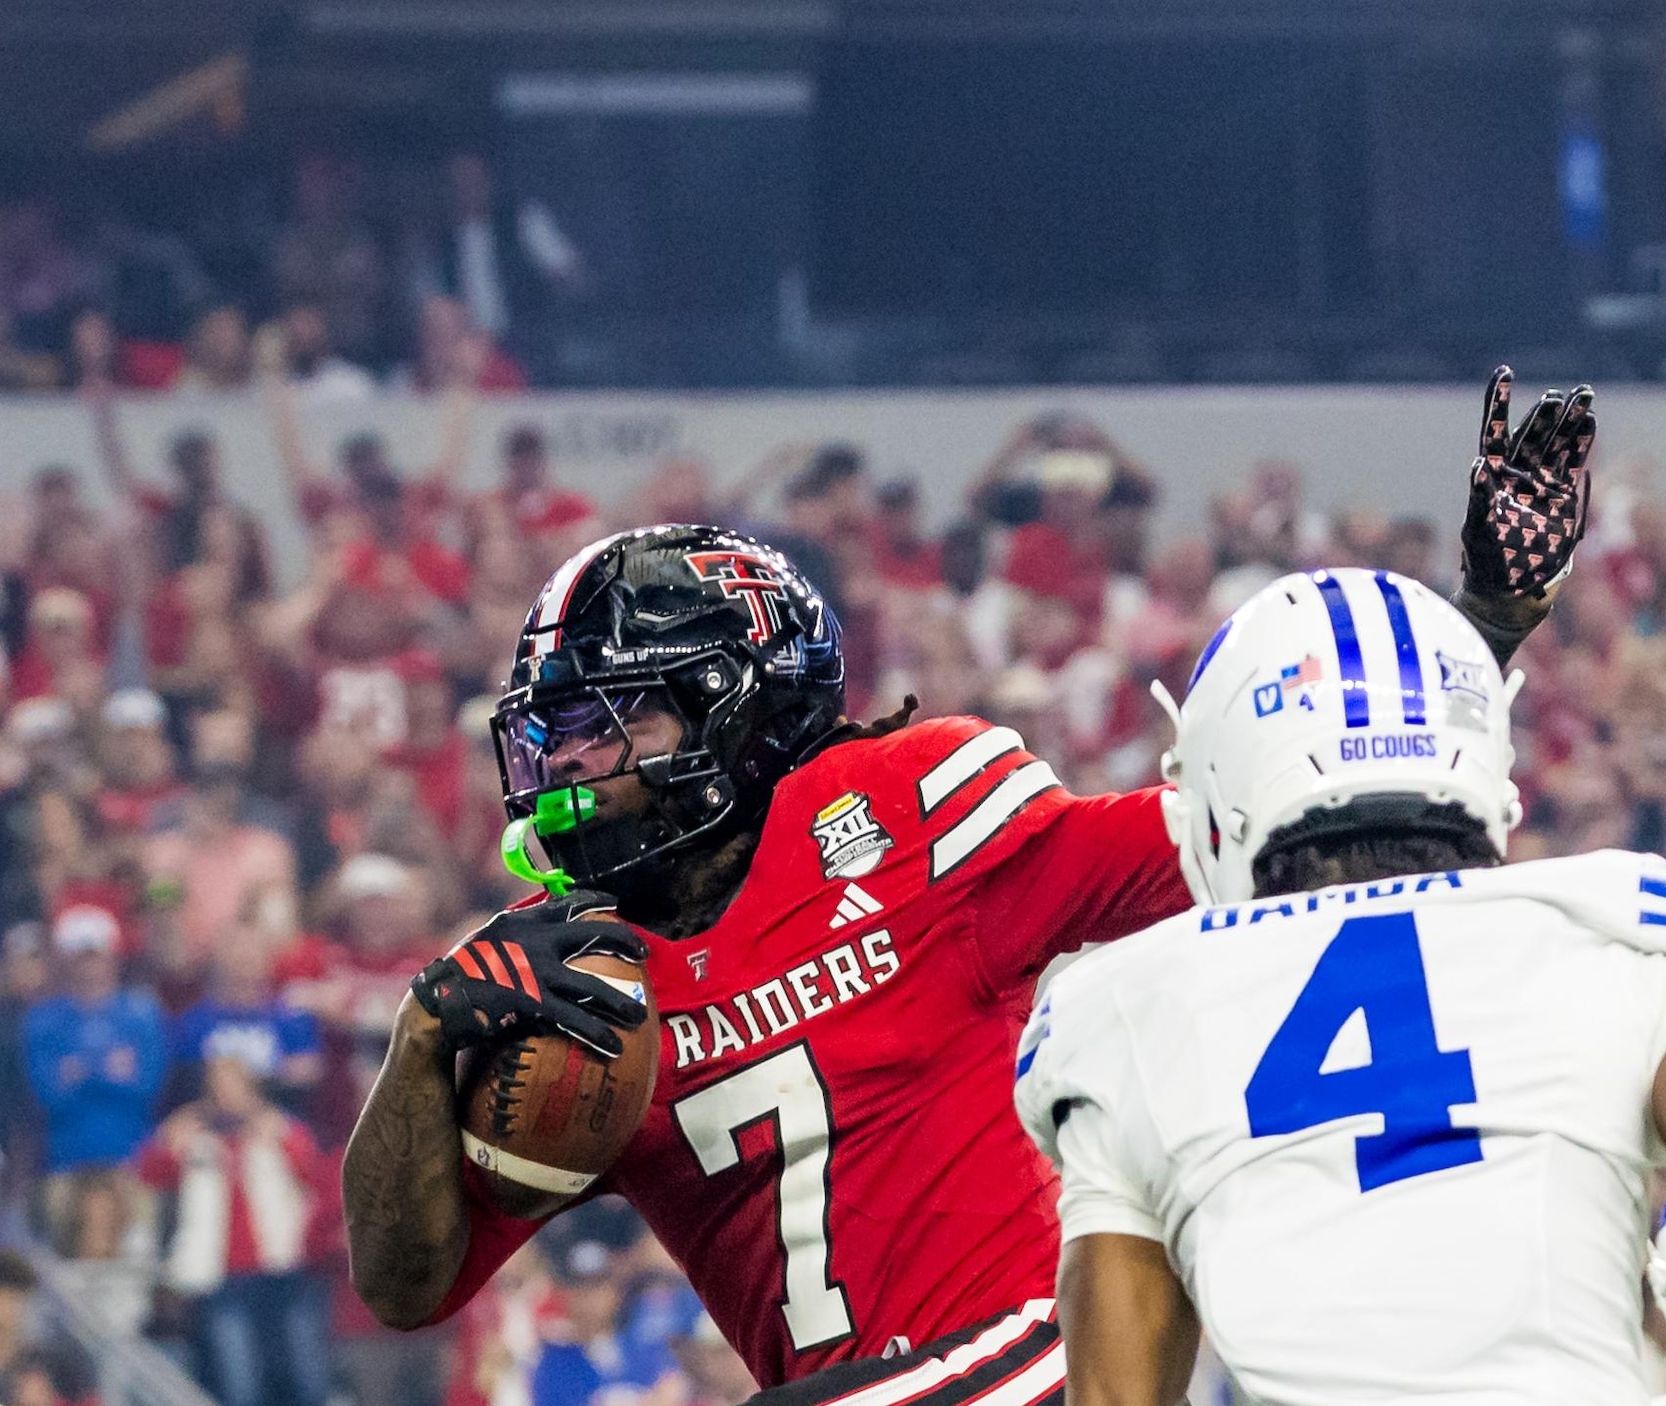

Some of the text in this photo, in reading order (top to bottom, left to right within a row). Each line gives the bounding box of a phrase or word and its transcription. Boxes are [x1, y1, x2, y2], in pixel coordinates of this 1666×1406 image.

[1299, 694, 1314, 711] 4
[1339, 733, 1438, 761] GO COUGS
[666, 928, 901, 1069] RAIDERS
[1244, 912, 1483, 1193] 4
[671, 1038, 856, 1353] 7
